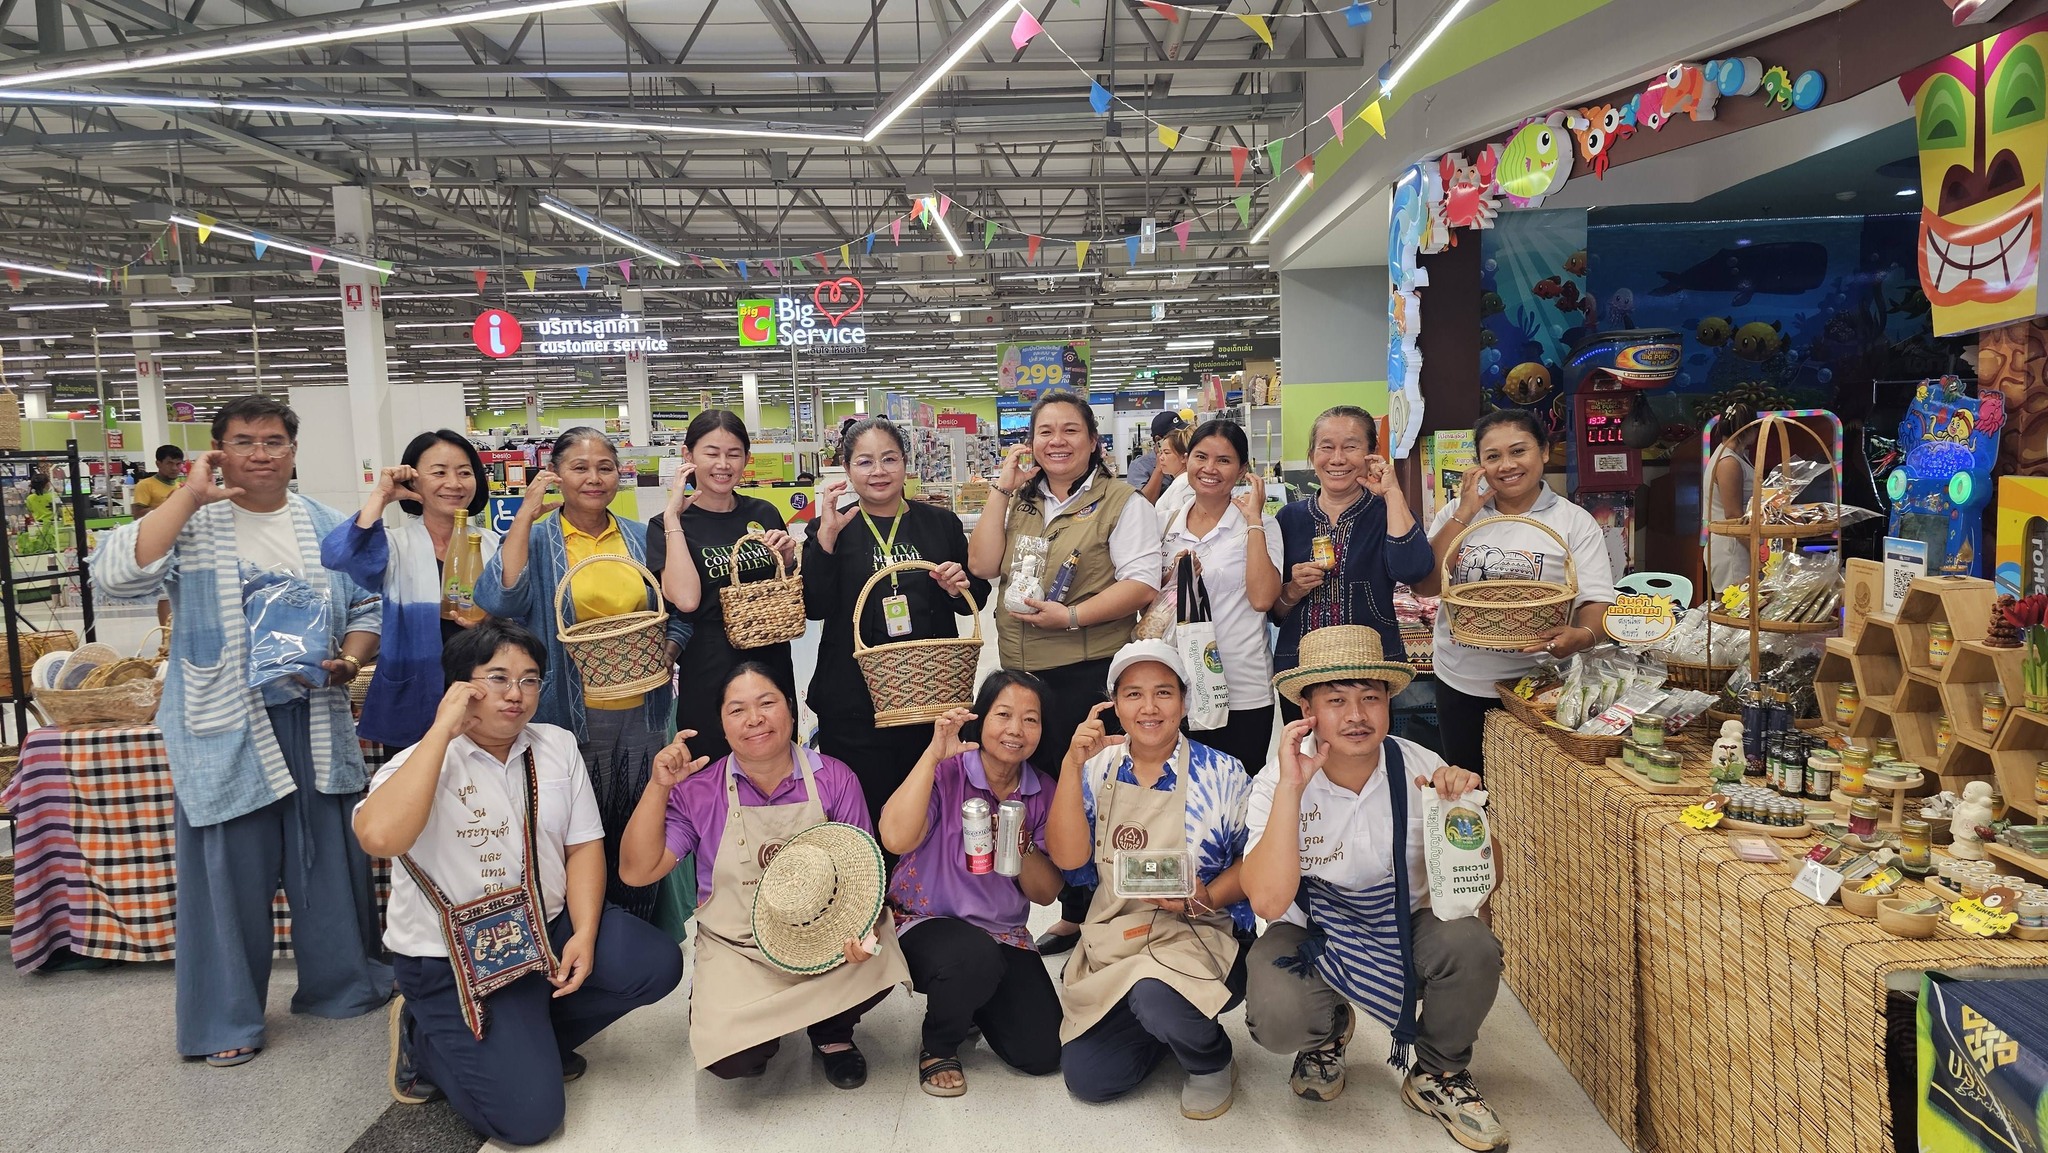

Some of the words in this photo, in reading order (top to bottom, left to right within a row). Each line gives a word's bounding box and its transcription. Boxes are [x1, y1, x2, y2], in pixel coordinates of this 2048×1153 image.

[740, 307, 759, 317] Big
[779, 298, 815, 328] Big
[538, 313, 639, 339] บริการลูกค้า
[742, 305, 772, 342] C
[780, 322, 866, 346] Service
[540, 339, 609, 353] customer
[617, 336, 668, 352] service
[1218, 343, 1253, 353] ของเด็กเล่น
[1016, 363, 1063, 386] 299
[110, 406, 116, 419] 8
[701, 541, 763, 558] CULTIVA
[704, 546, 770, 568] COMITME
[709, 556, 774, 579] CHLLEN
[1608, 604, 1661, 615] ยอดนิยม
[1300, 803, 1322, 832] บูชา
[1299, 836, 1324, 852] คุณ
[480, 852, 502, 863] และ
[1300, 841, 1344, 871] ะพุทธเจ้า
[481, 866, 506, 878] แทน
[1452, 862, 1489, 873] รสหวาน
[1453, 872, 1491, 883] ทานง่าย
[484, 881, 504, 897] คุณ
